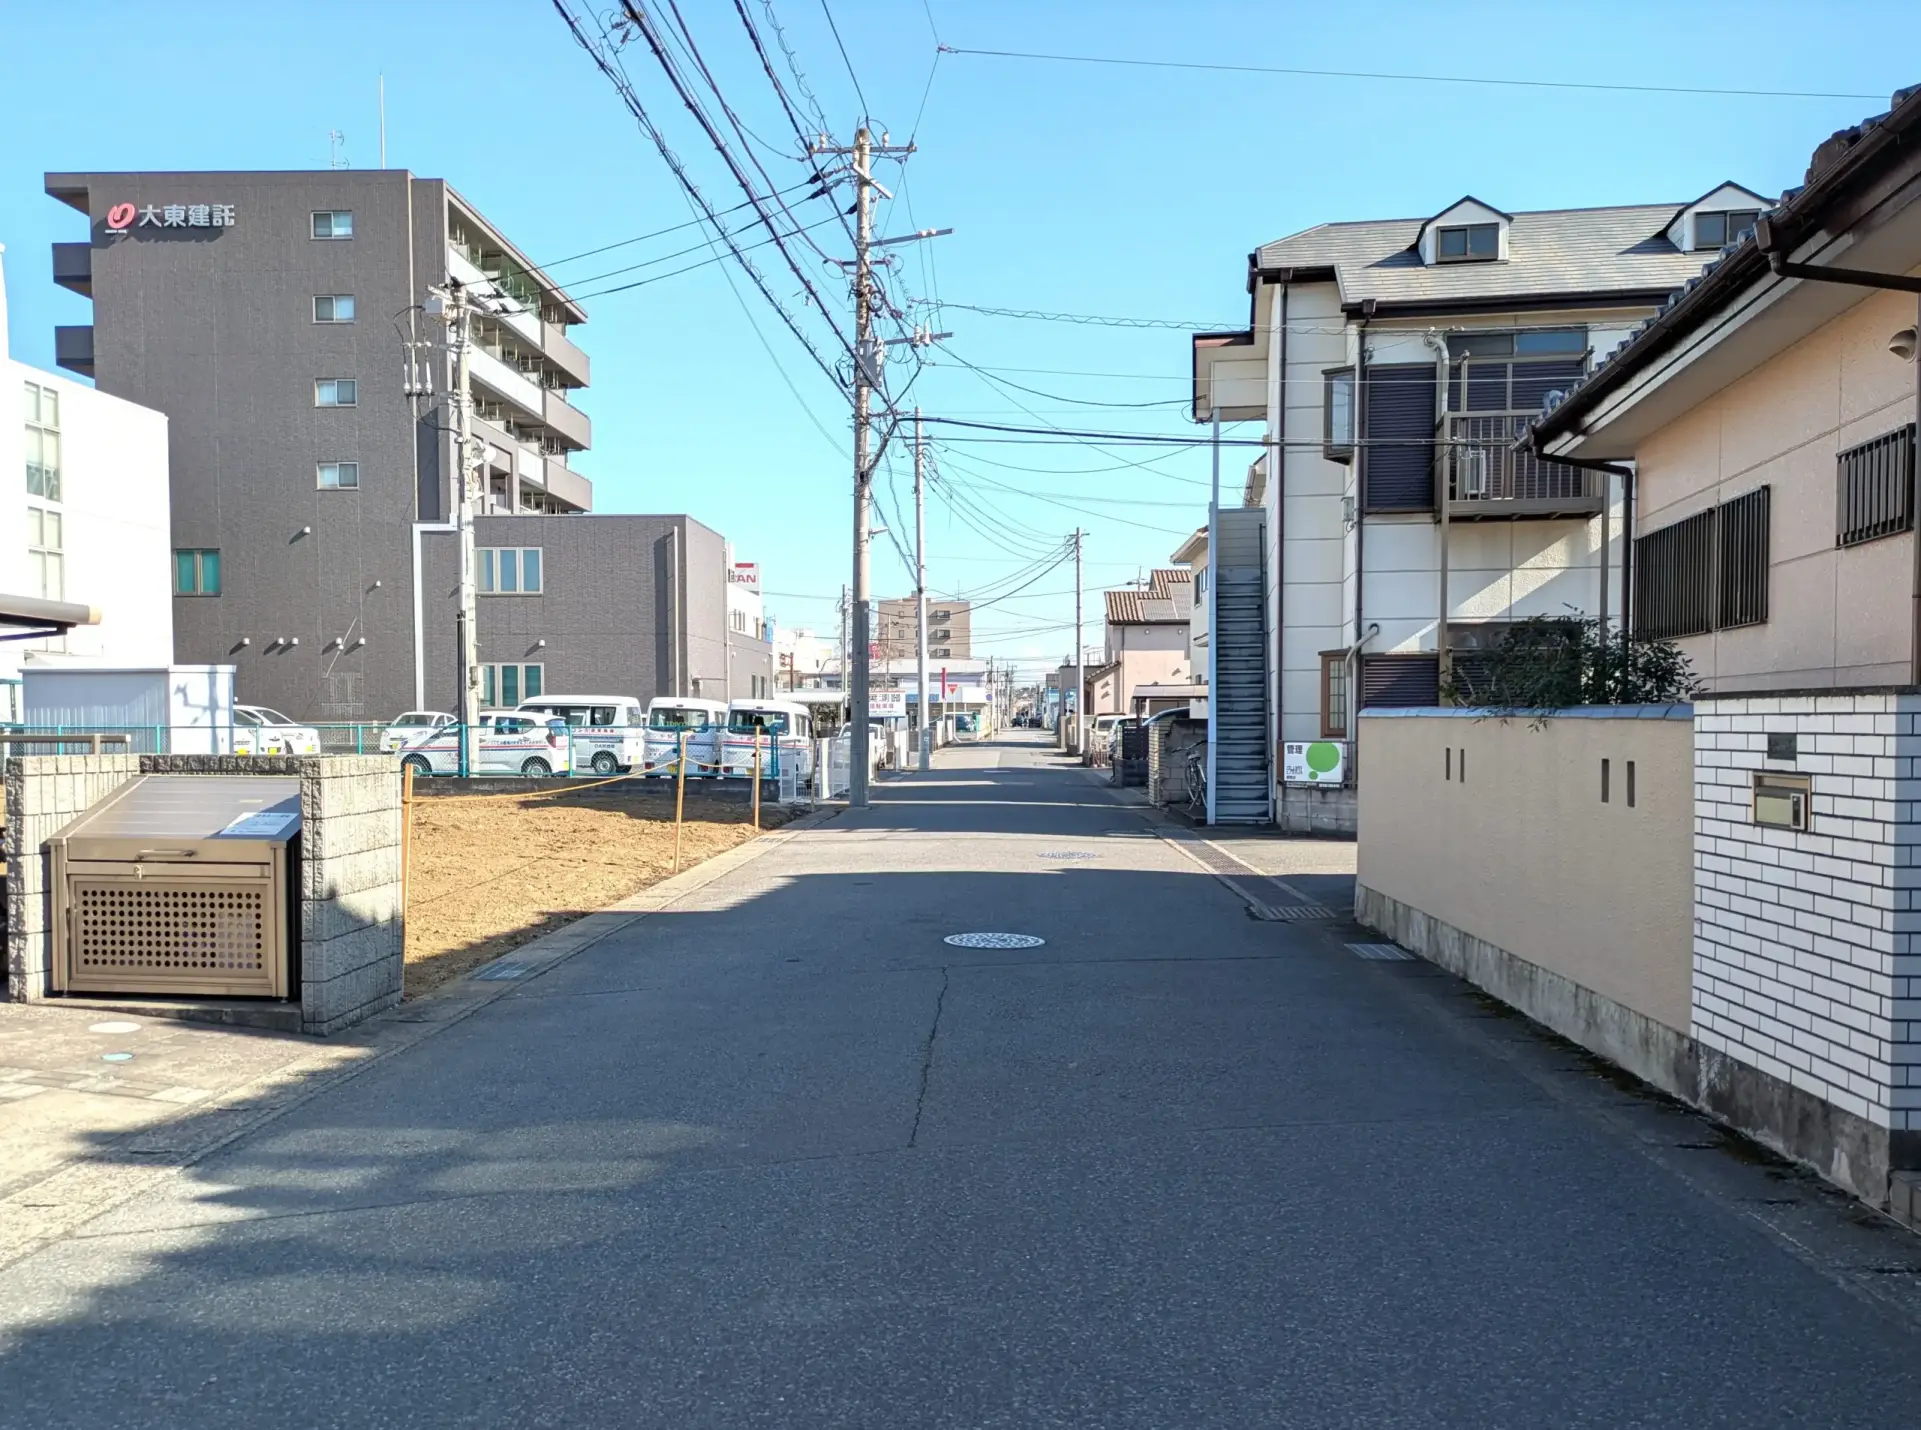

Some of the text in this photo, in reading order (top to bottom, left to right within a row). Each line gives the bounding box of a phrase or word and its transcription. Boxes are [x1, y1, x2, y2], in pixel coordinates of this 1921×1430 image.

[138, 204, 235, 228] 大東建託
[735, 574, 757, 583] AN
[1286, 744, 1303, 755] 管理
